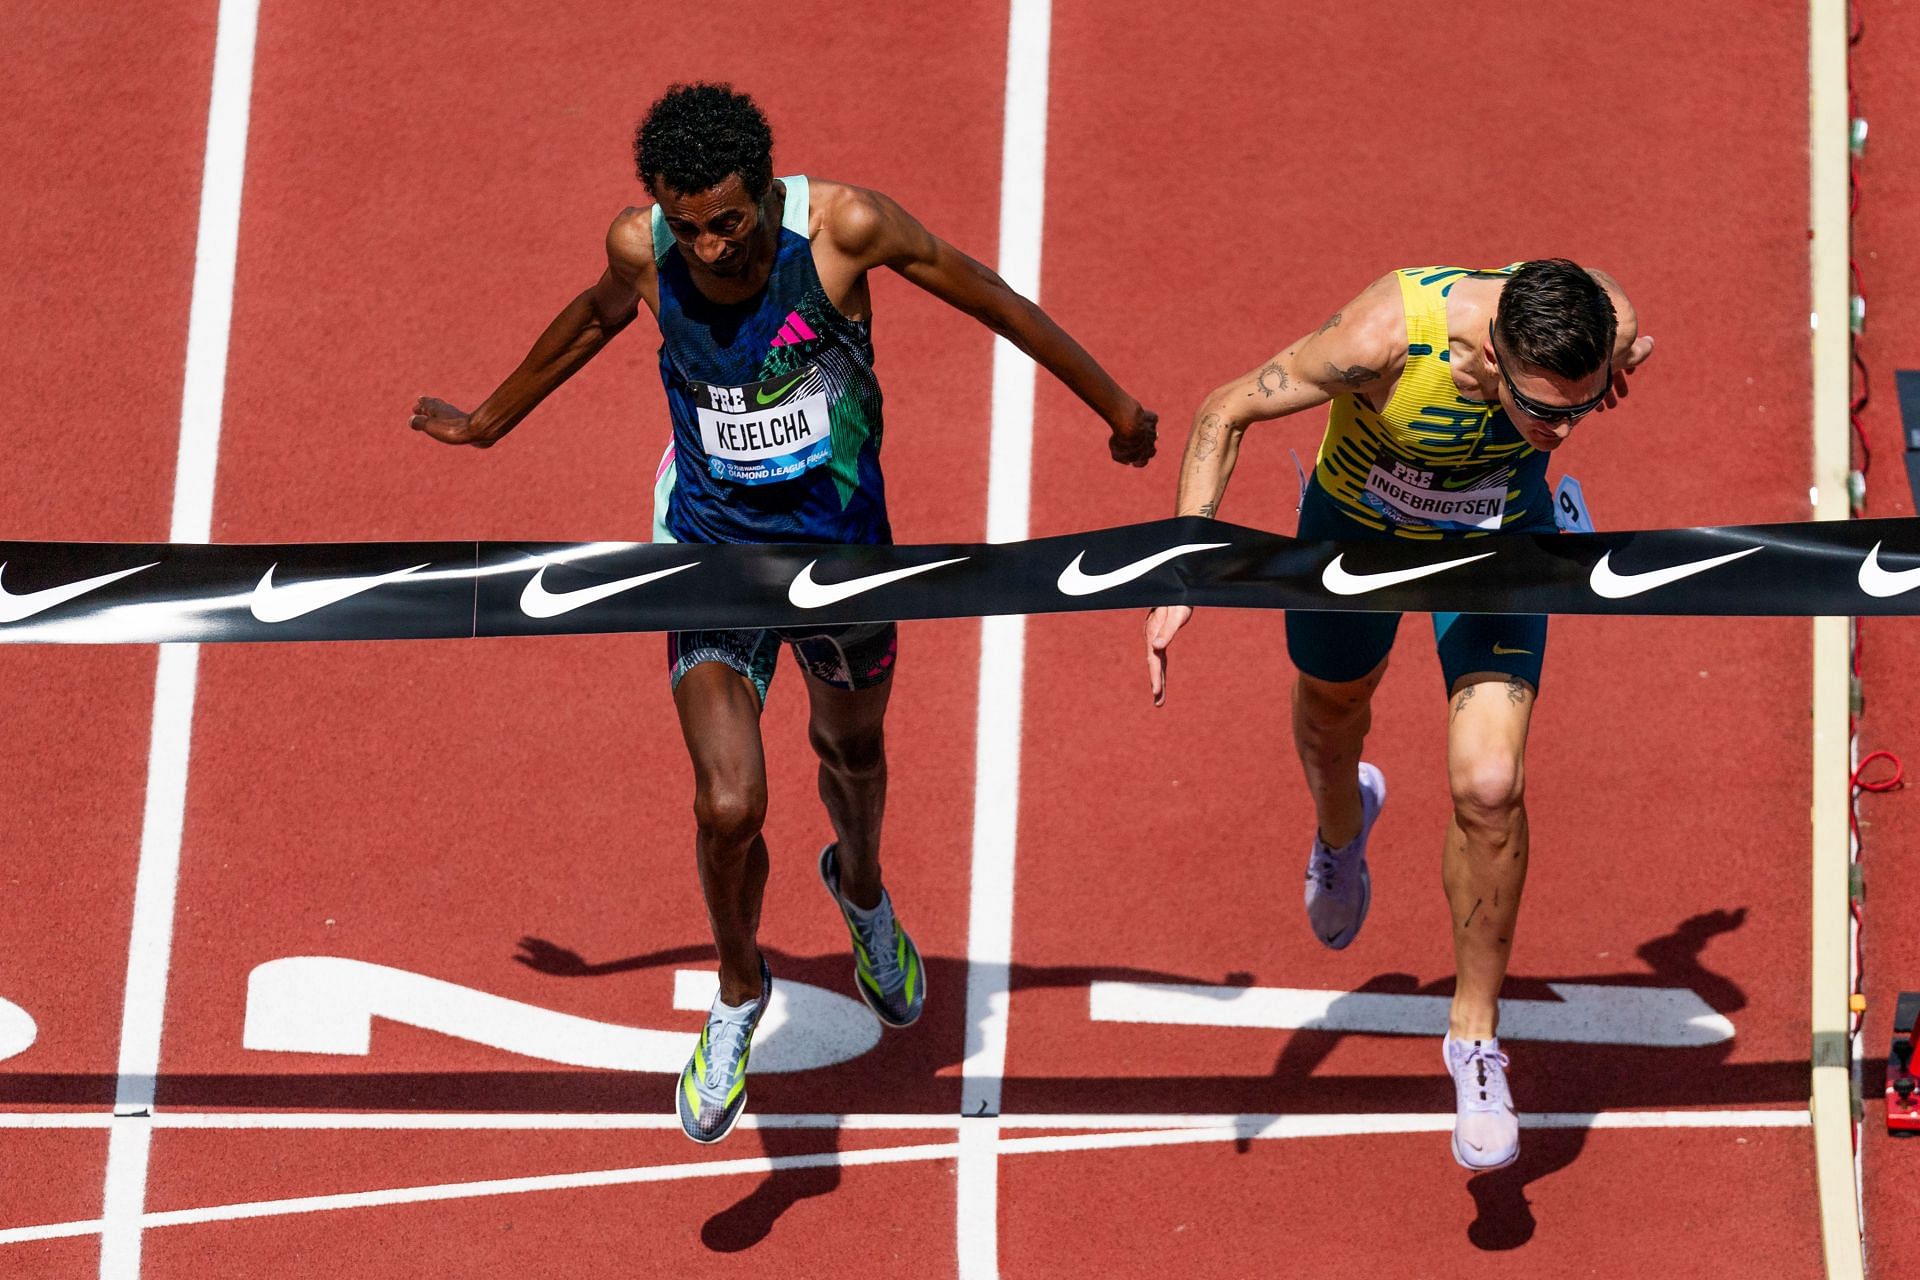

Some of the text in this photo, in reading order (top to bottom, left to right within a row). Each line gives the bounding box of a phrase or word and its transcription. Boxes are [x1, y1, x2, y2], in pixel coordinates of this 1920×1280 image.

[707, 385, 747, 413] PRE
[716, 409, 811, 451] KEJELCHA
[729, 470, 769, 480] DIAMOND
[771, 459, 806, 477] LEAGUE
[1392, 461, 1433, 489] PRE
[1371, 474, 1501, 517] INGEBRIGTSEN
[243, 956, 884, 1074] 2
